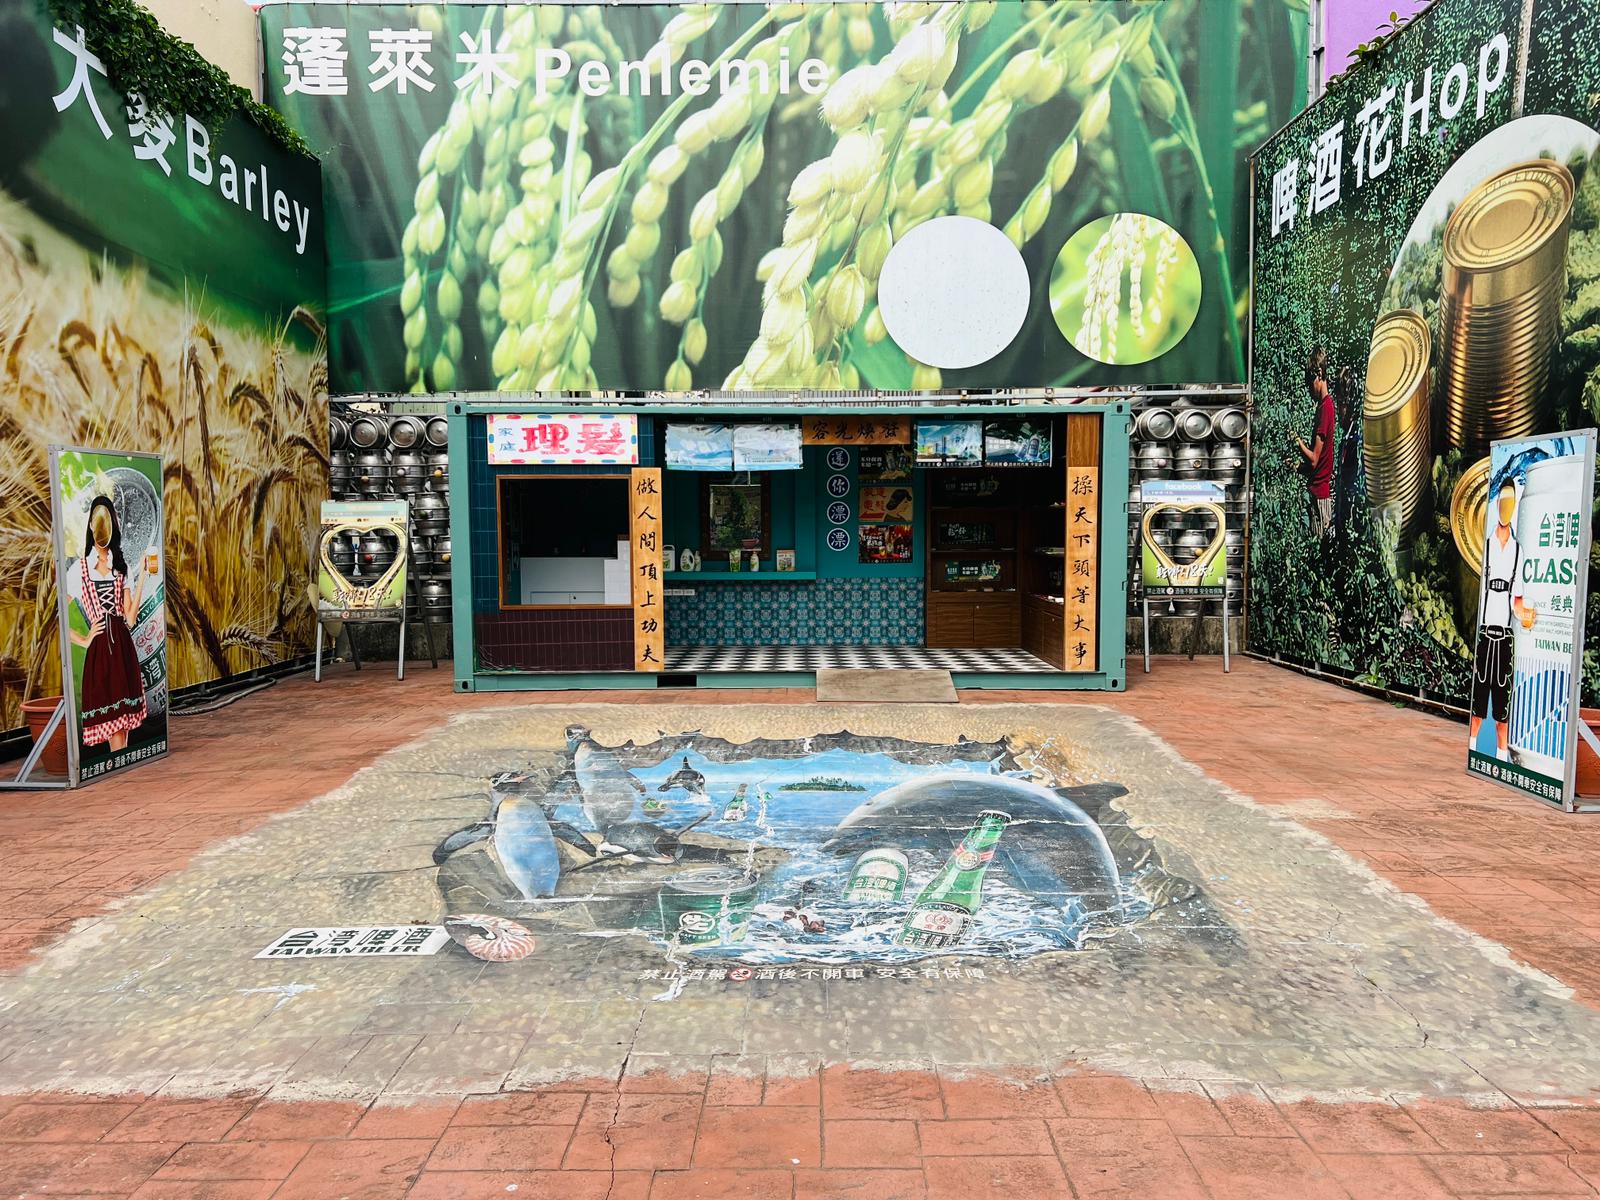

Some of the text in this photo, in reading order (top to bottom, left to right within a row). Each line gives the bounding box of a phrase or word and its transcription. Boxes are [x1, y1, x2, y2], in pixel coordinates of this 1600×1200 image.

[282, 26, 521, 95] 蓬萊米
[535, 46, 829, 97] Penlemie
[1400, 33, 1509, 150] Hop
[185, 113, 310, 255] Barley
[1271, 86, 1396, 238] 啤酒花
[518, 422, 627, 455] 理髮
[636, 477, 660, 664] 做人間頂上功夫
[1072, 476, 1093, 666] 操天下頭等大事
[1551, 595, 1573, 613] 經典
[1535, 639, 1561, 652] TAIWAN
[755, 968, 865, 981] 酒後不開車
[876, 967, 987, 980] 安全有保障
